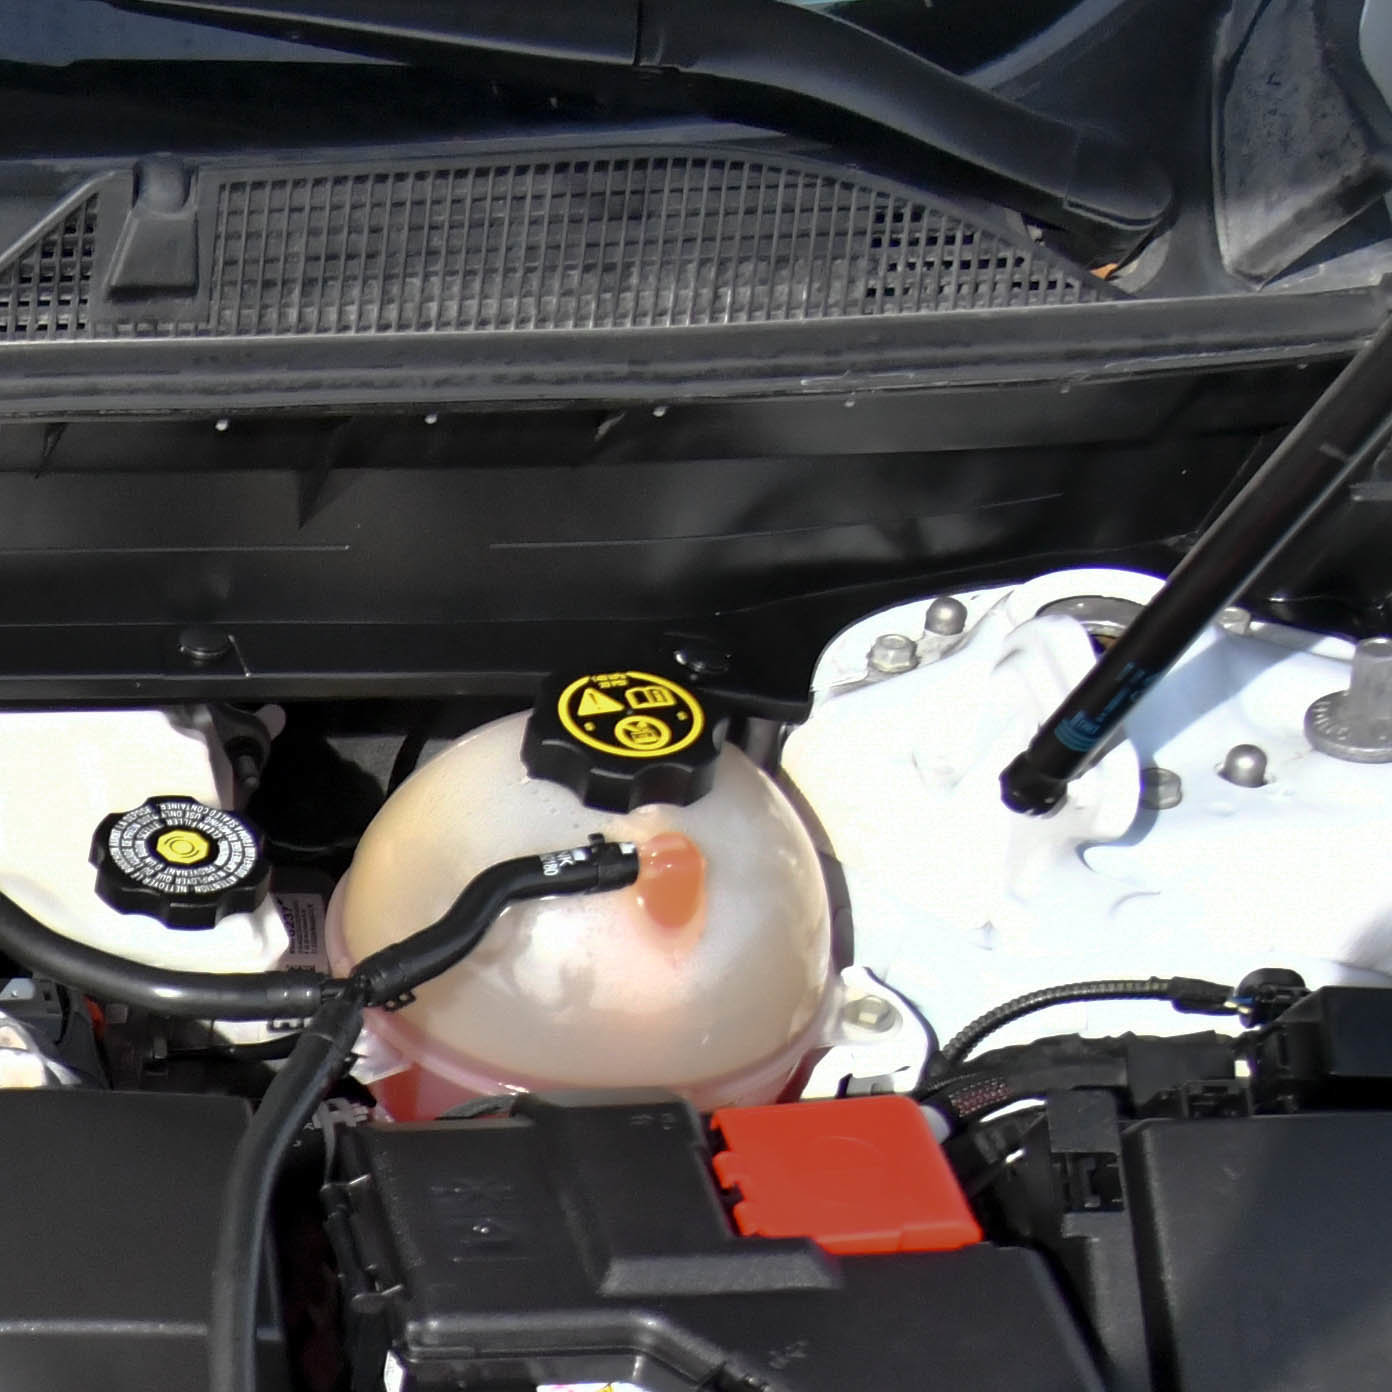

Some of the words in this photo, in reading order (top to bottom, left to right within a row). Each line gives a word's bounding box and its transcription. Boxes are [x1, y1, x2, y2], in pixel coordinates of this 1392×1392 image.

[159, 802, 209, 815] CONTAINER
[160, 810, 183, 818] ONLY
[185, 811, 201, 822] USE
[166, 818, 197, 829] FILLER
[198, 822, 222, 839] CLEAN
[141, 878, 188, 893] NETTOYER
[194, 876, 237, 893] ATTENTION
